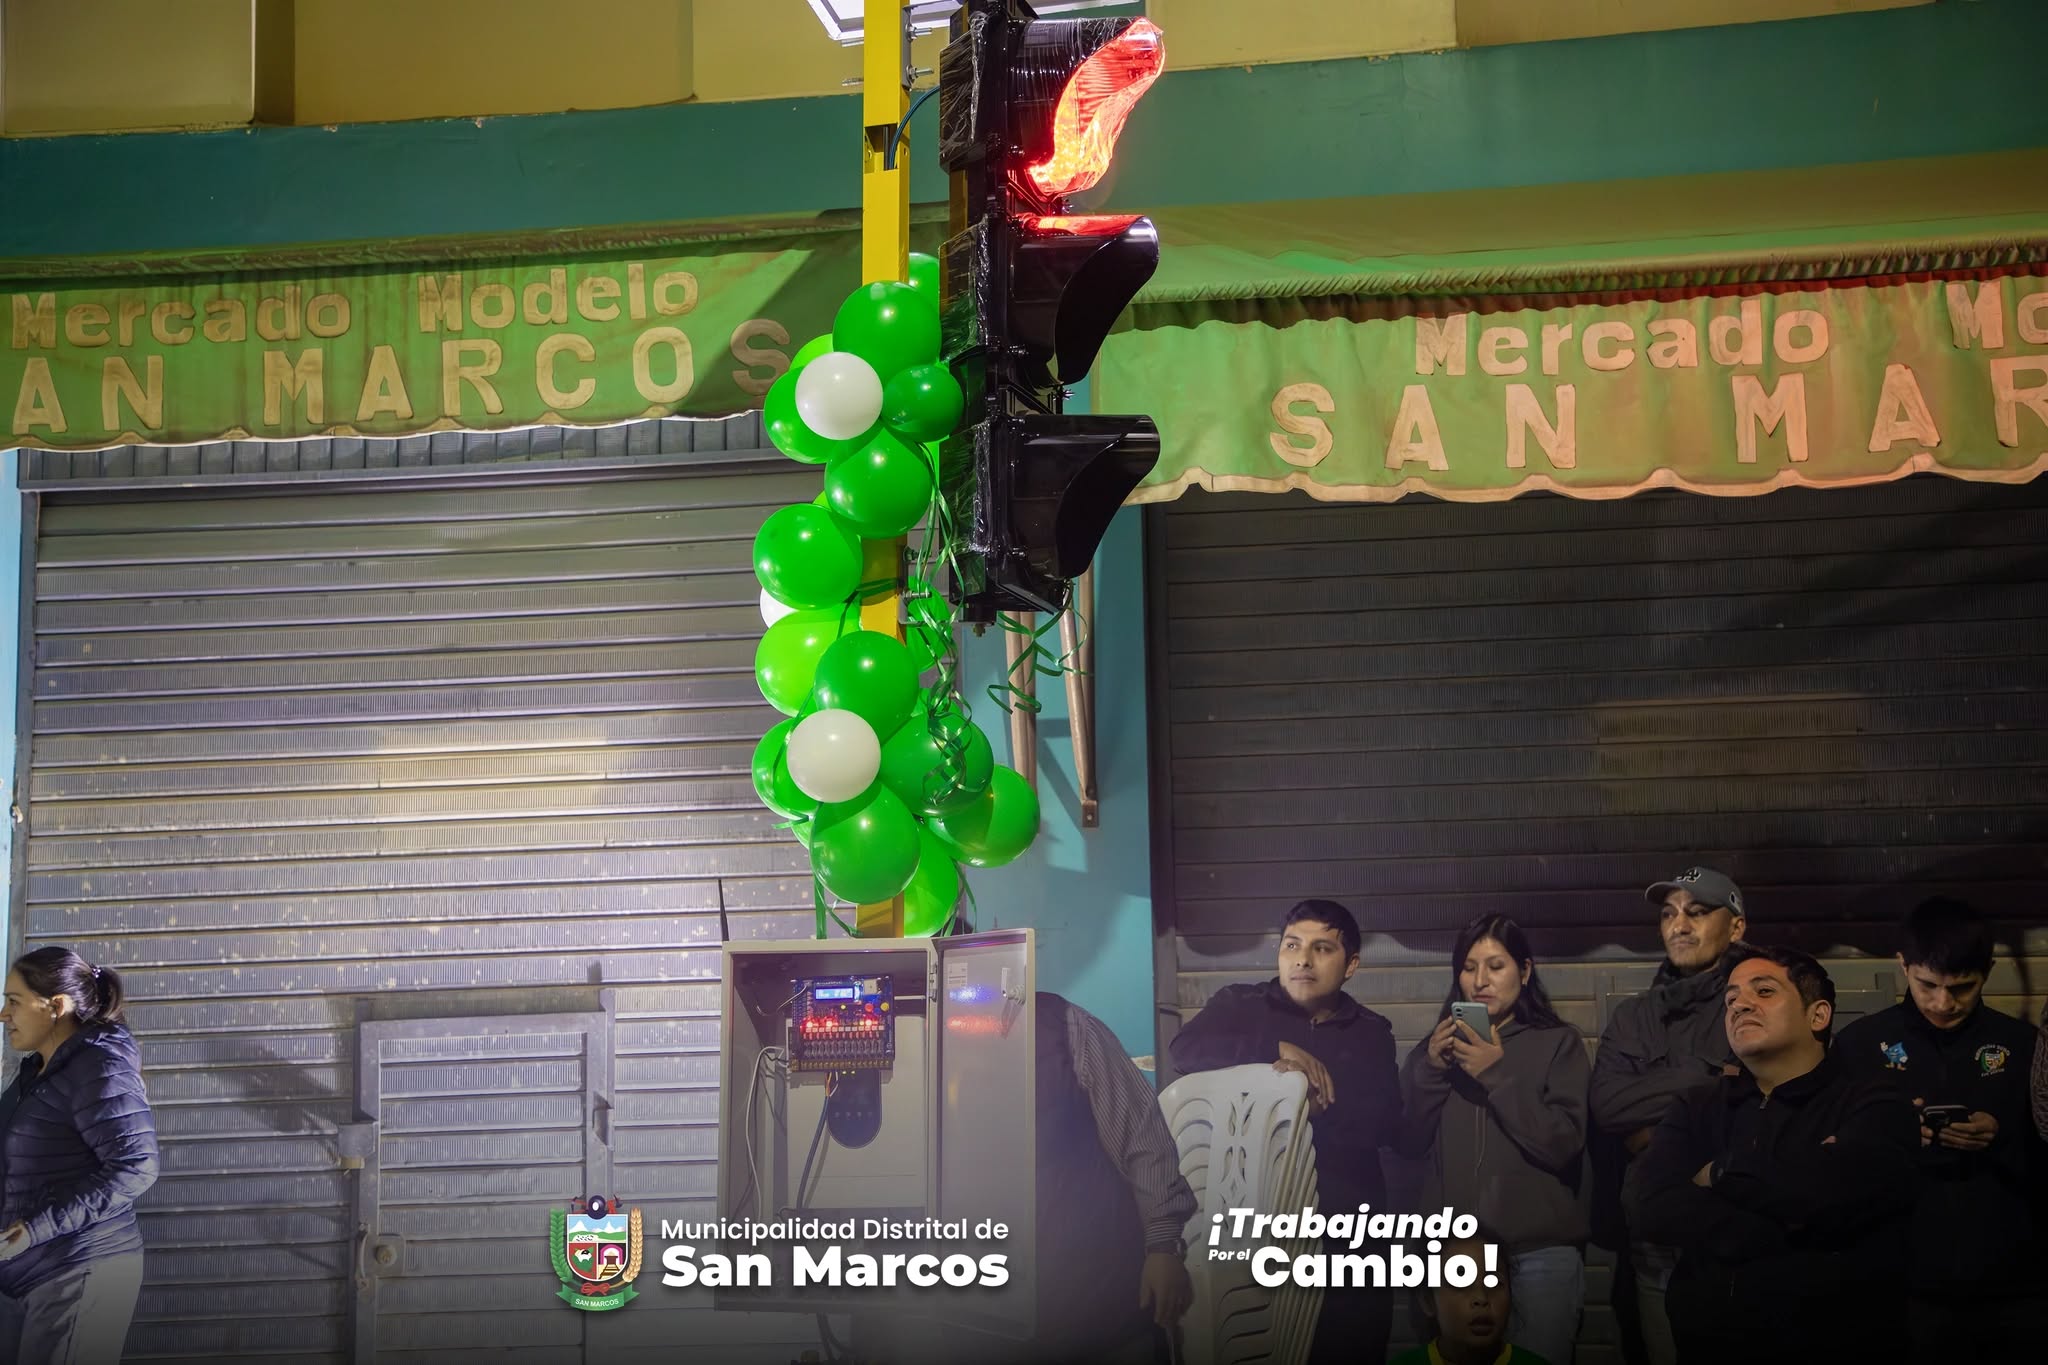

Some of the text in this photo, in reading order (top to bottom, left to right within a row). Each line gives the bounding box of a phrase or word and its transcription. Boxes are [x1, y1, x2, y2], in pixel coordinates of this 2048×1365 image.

[12, 263, 699, 349] Mercado Modelo
[1415, 299, 1829, 376] Mercado
[263, 319, 791, 426] MARCOS
[1269, 355, 2048, 471] SAN MAR
